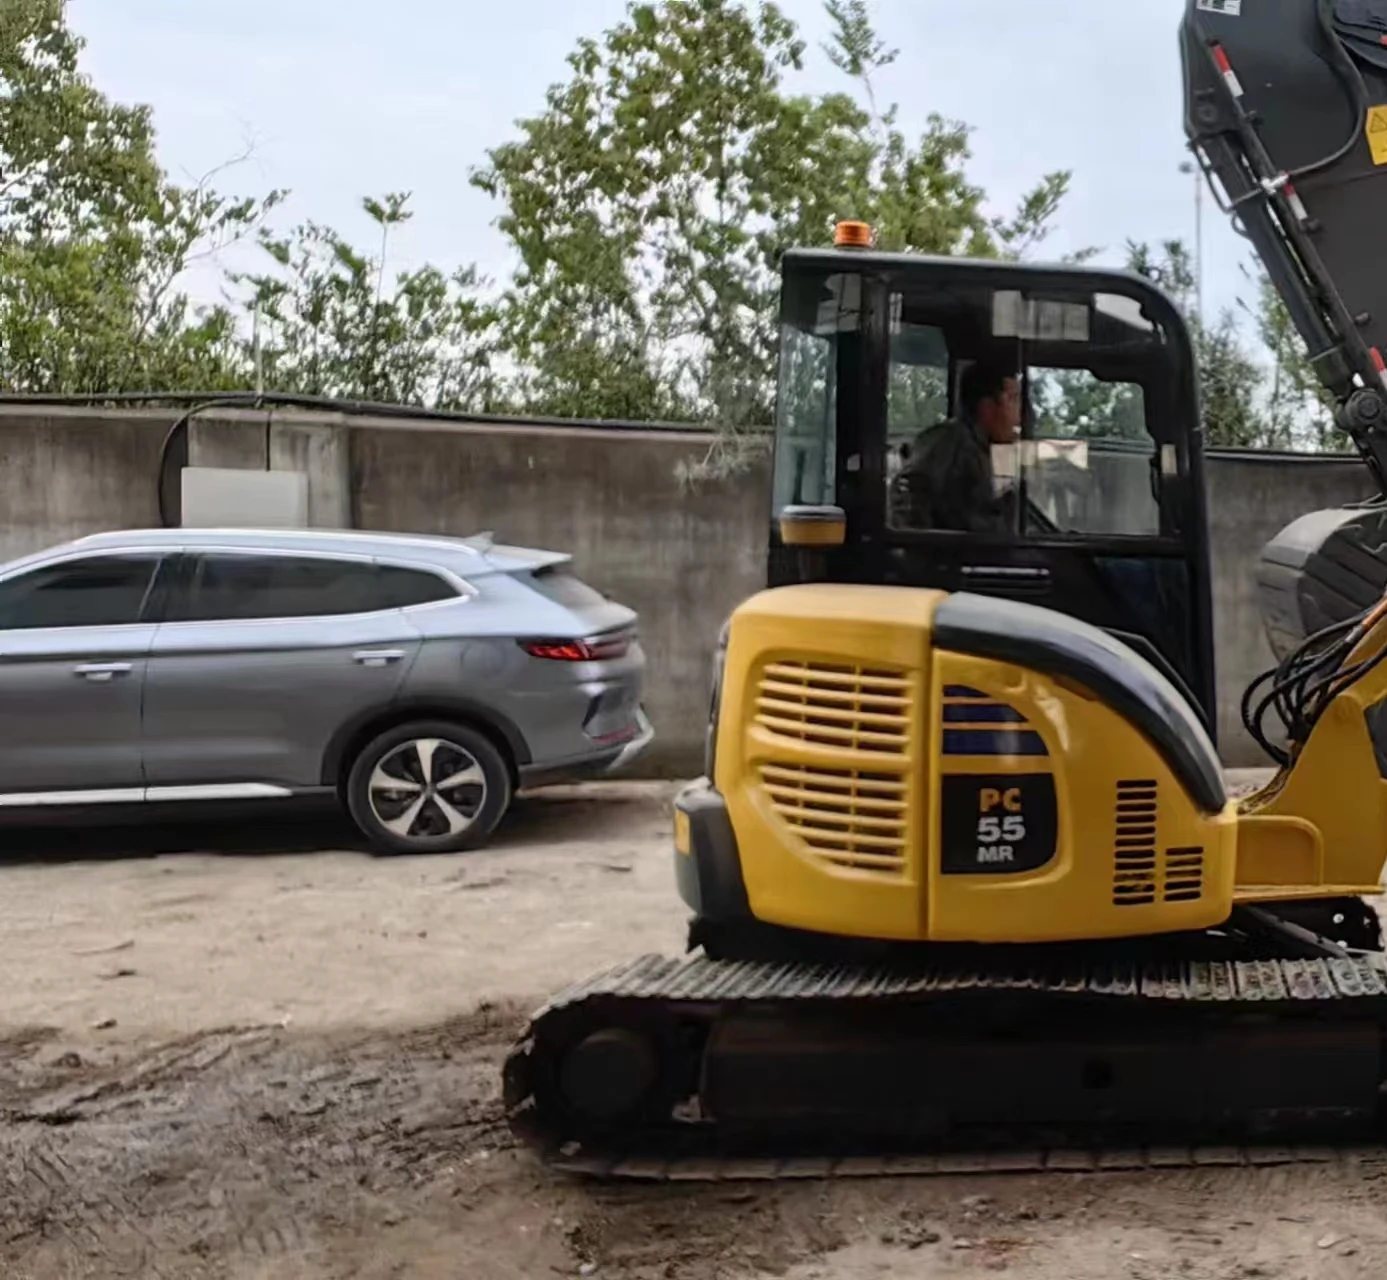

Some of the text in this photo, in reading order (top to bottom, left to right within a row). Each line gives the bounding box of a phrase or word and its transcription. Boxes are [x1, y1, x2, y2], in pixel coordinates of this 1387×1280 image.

[980, 787, 1021, 812] PC
[977, 815, 1026, 842] 55
[977, 845, 1014, 862] MR
